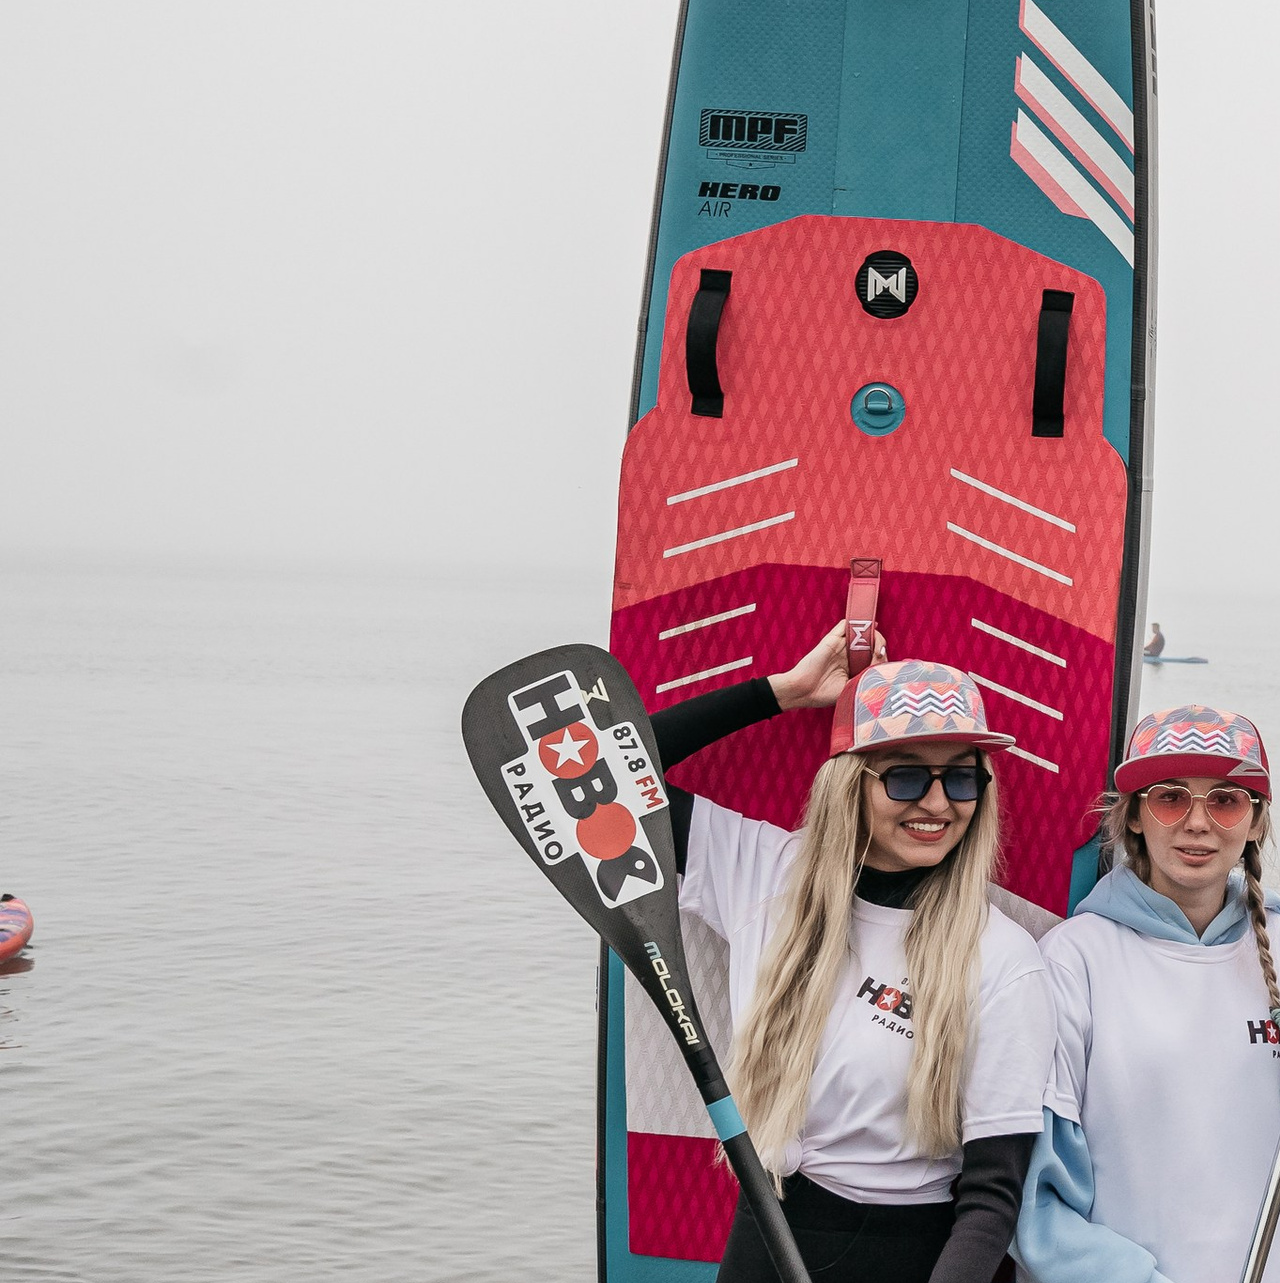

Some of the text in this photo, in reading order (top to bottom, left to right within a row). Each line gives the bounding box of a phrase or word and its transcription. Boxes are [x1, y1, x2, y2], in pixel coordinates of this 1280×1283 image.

[708, 114, 799, 145] MPF
[698, 182, 781, 201] HERO
[698, 201, 732, 217] AIR
[613, 725, 664, 810] 87.8 FM
[506, 762, 563, 860] РАДИО
[643, 941, 700, 1045] MOLOKAI
[856, 976, 914, 1020] НОВ
[871, 1014, 914, 1039] РАДИО
